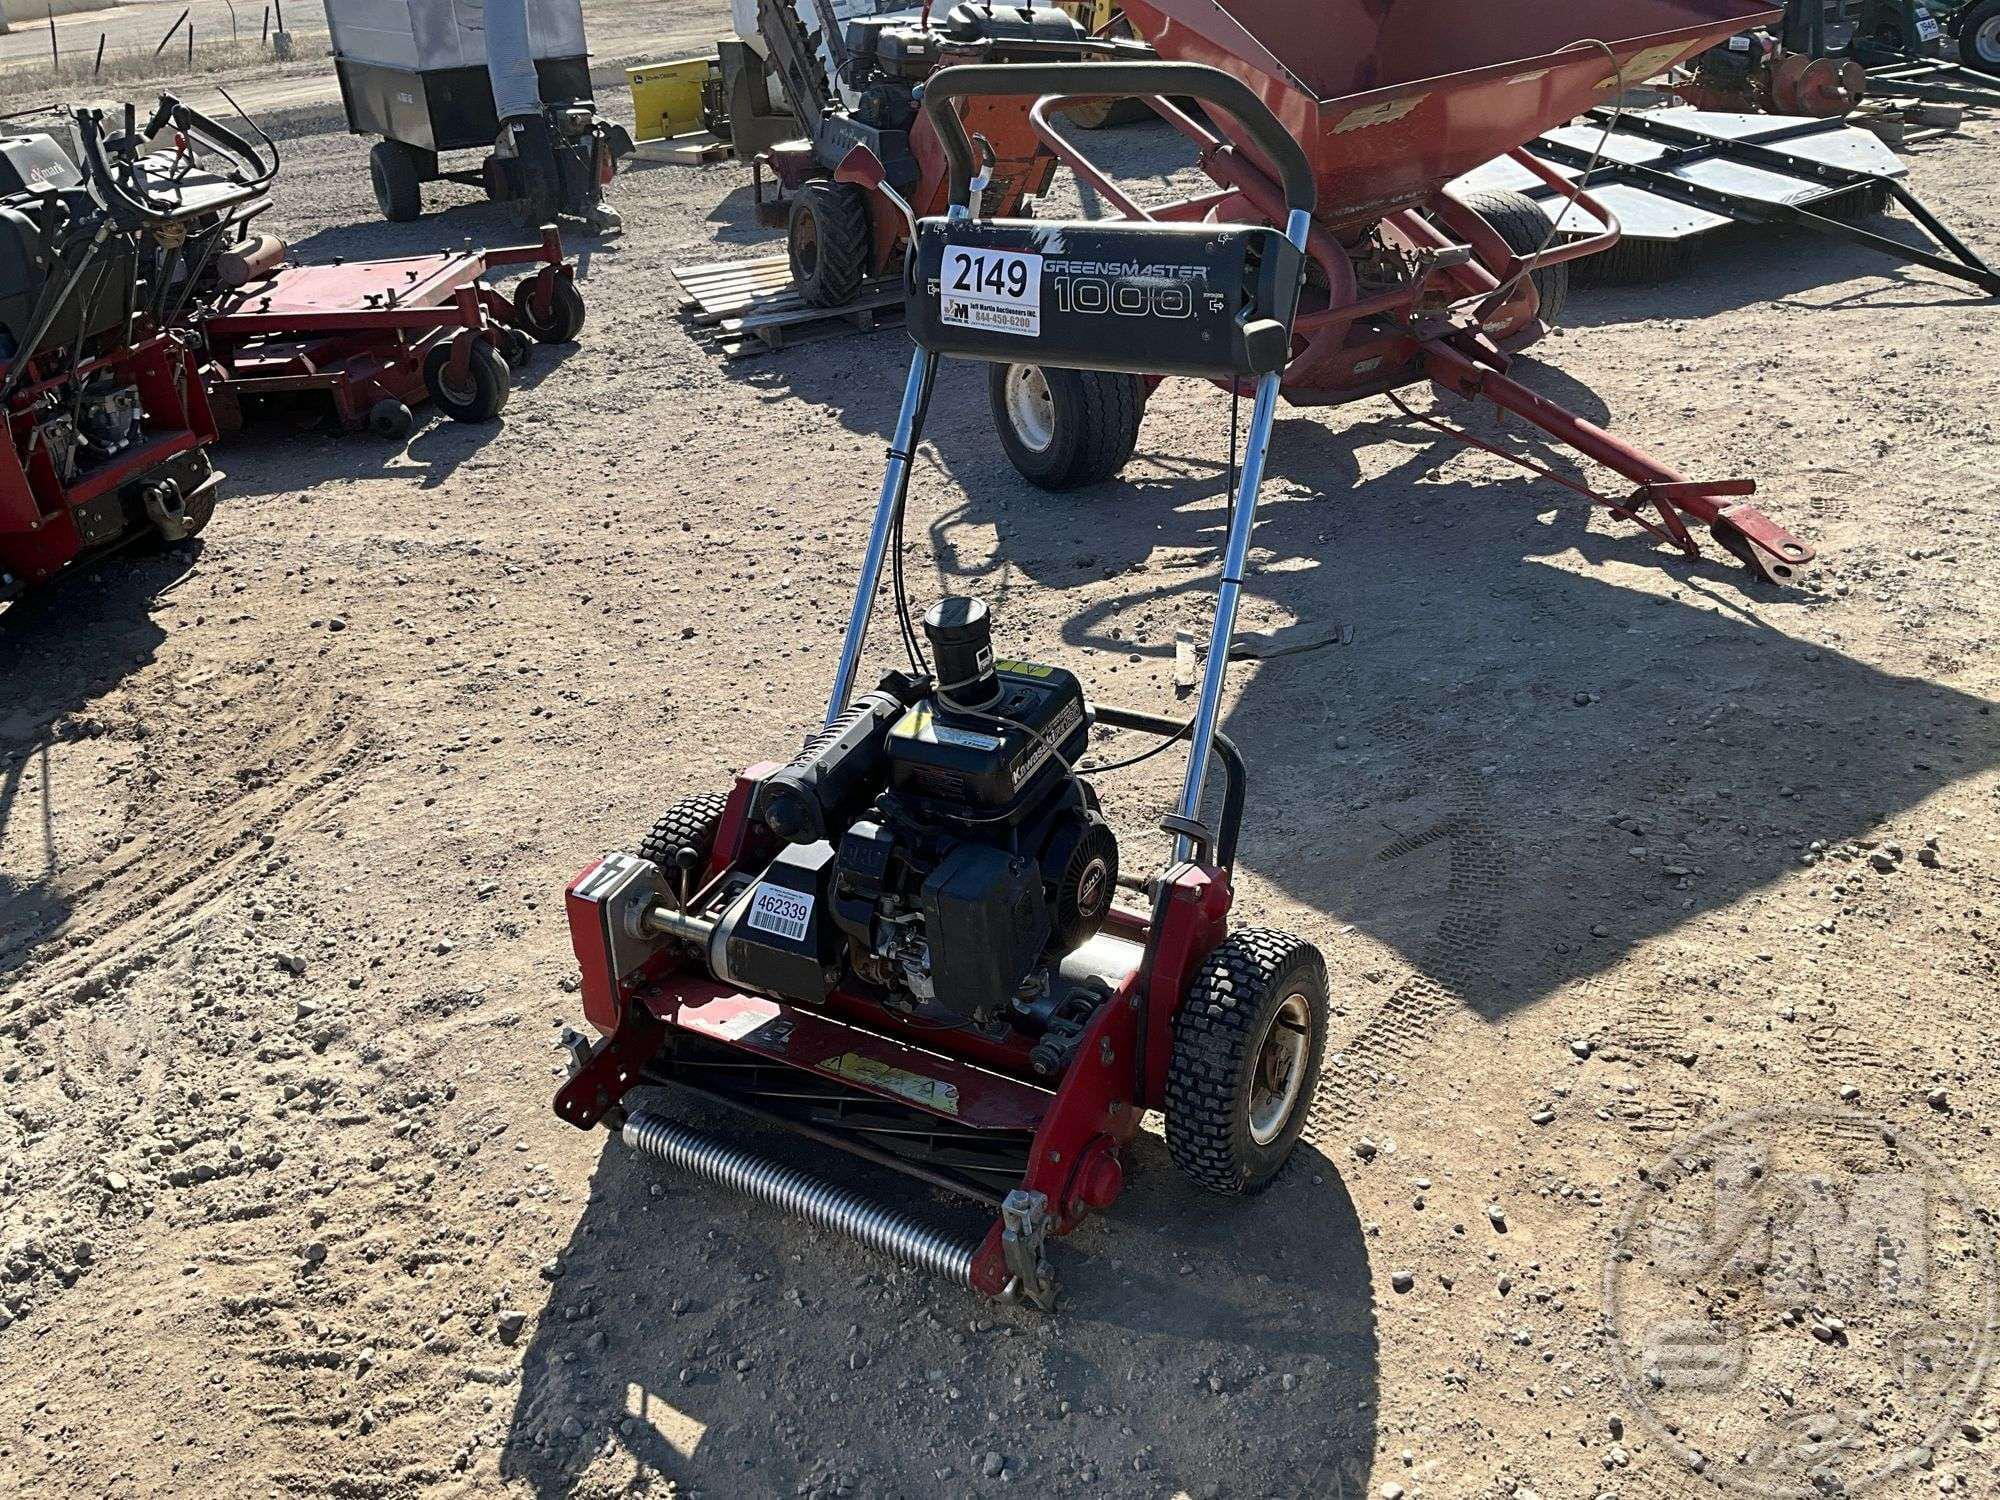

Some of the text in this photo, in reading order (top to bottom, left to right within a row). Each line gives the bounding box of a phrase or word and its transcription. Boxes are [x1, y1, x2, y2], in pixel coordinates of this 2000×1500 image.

[953, 253, 1027, 298] 2149
[1043, 259, 1208, 279] GREENSMASTER
[1054, 276, 1193, 319] 1000
[975, 311, 1031, 328] 844-450-6200
[757, 894, 808, 921] 462339
